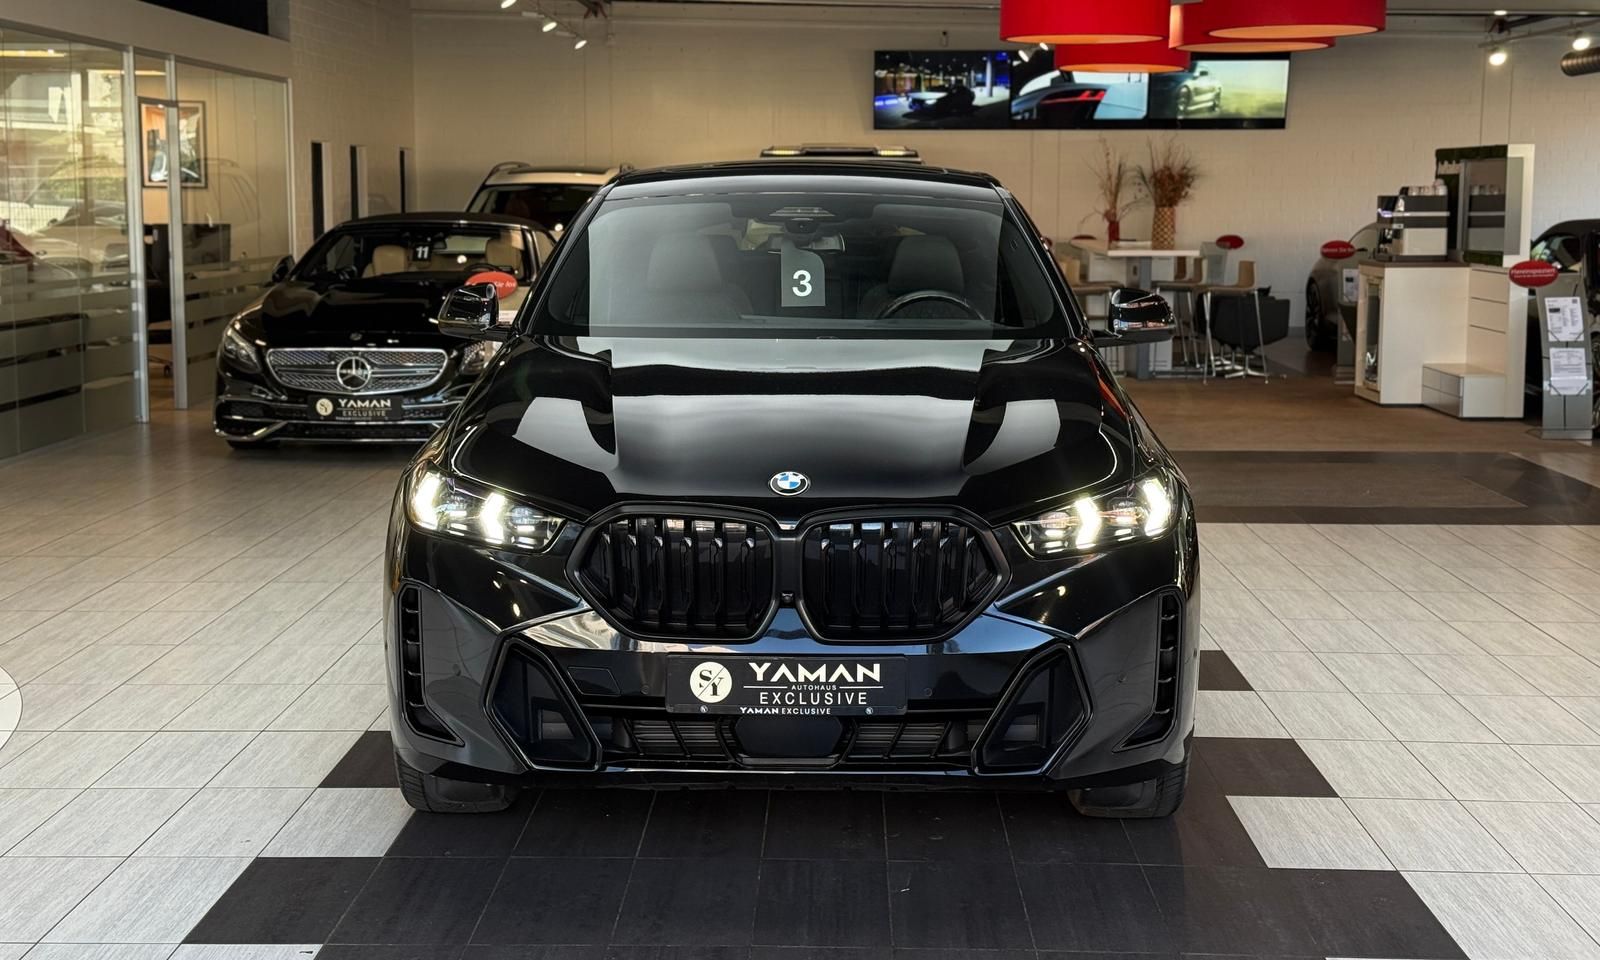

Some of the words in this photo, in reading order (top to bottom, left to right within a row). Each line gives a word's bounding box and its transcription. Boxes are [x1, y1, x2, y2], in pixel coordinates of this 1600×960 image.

[416, 246, 429, 259] 11
[792, 269, 812, 297] 3
[338, 398, 391, 408] YAMAN
[748, 662, 880, 683] YAMAN
[760, 692, 867, 705] EXCLUSIVE
